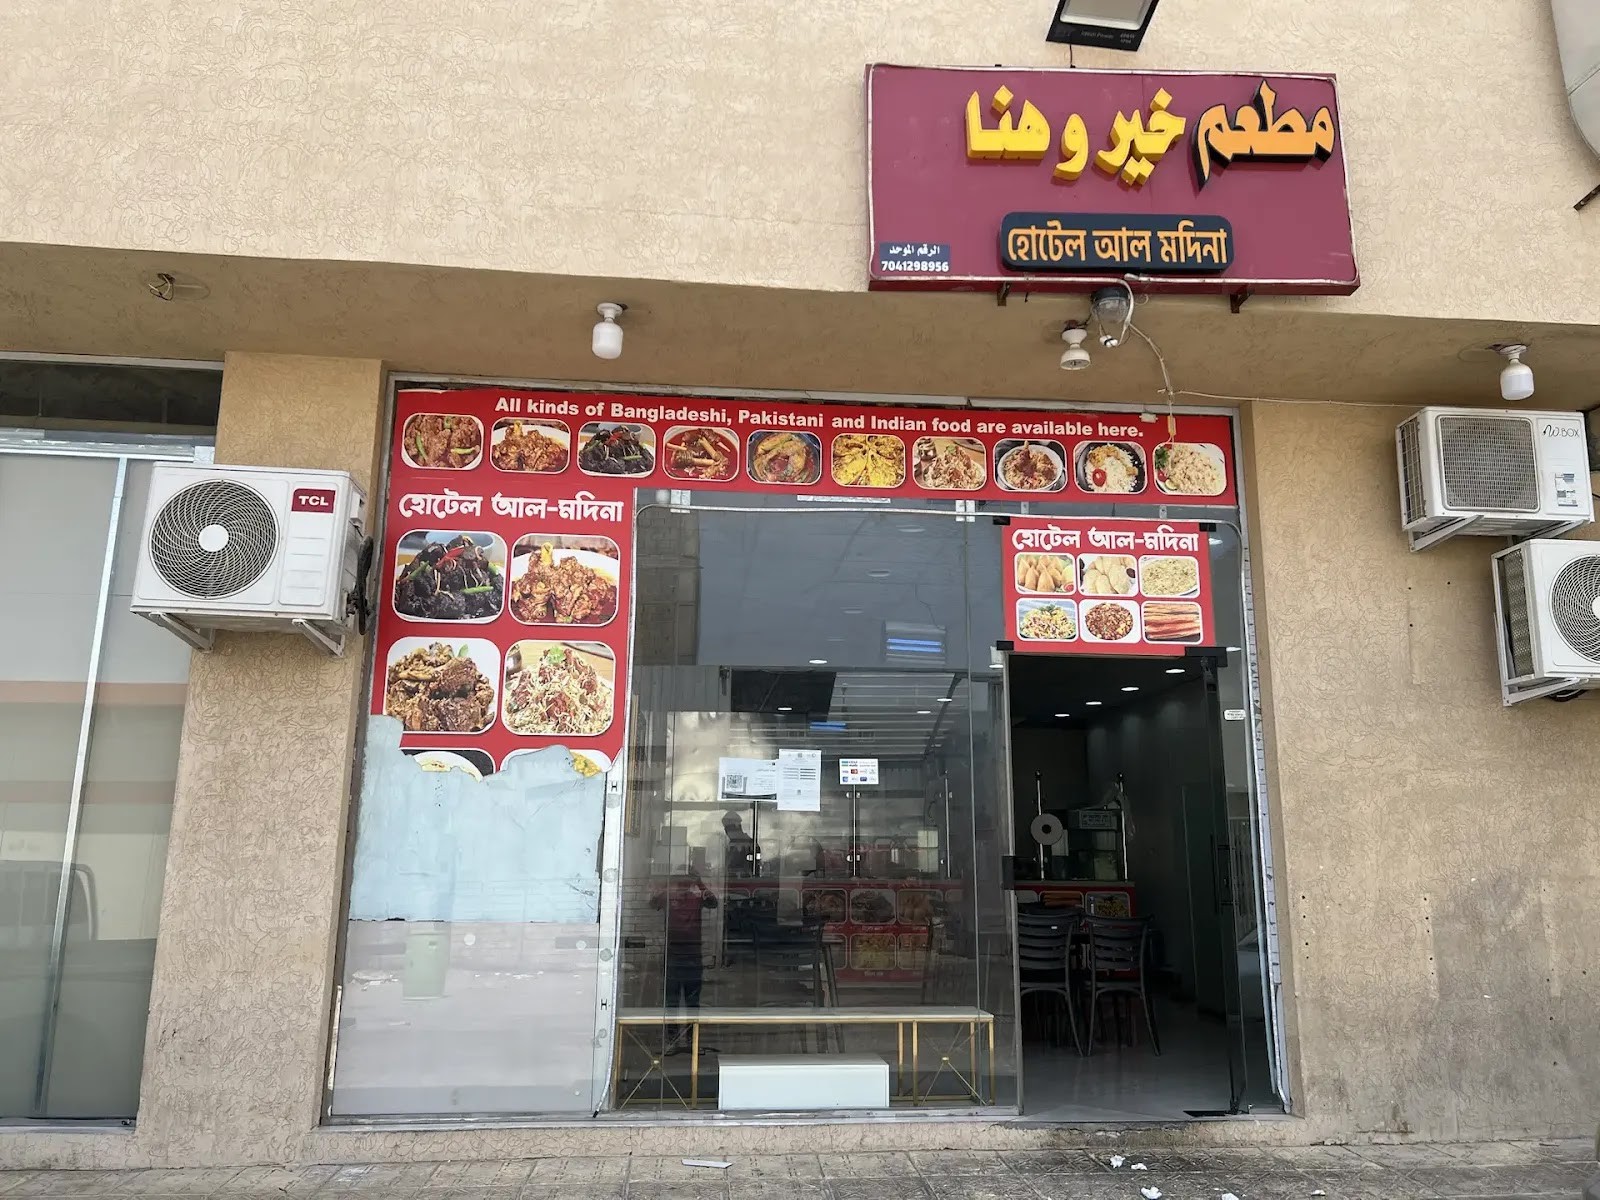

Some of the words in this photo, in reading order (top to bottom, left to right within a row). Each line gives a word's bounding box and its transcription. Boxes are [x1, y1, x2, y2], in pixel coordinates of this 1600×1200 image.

[1093, 87, 1187, 186] خير
[1192, 79, 1335, 191] مطعم
[889, 243, 915, 257] الموحد
[917, 243, 940, 257] الرقم
[1007, 219, 1087, 261] হোটেল
[1092, 227, 1152, 263] আল
[1156, 219, 1228, 264] মদিনা
[881, 260, 950, 273] 7041298956
[495, 397, 521, 413] All
[527, 399, 579, 416] kinds
[585, 401, 605, 417] of
[610, 403, 732, 426] Bangladeshi,
[738, 409, 824, 427] Pakistani
[831, 414, 865, 429] and
[871, 416, 927, 431] Indian
[931, 417, 971, 433] food
[976, 422, 1006, 434] are
[1011, 421, 1093, 438] available
[1098, 424, 1144, 438] here.
[298, 495, 329, 507] TCL
[398, 487, 484, 520] হোটেল
[1011, 523, 1082, 552] হোটেল
